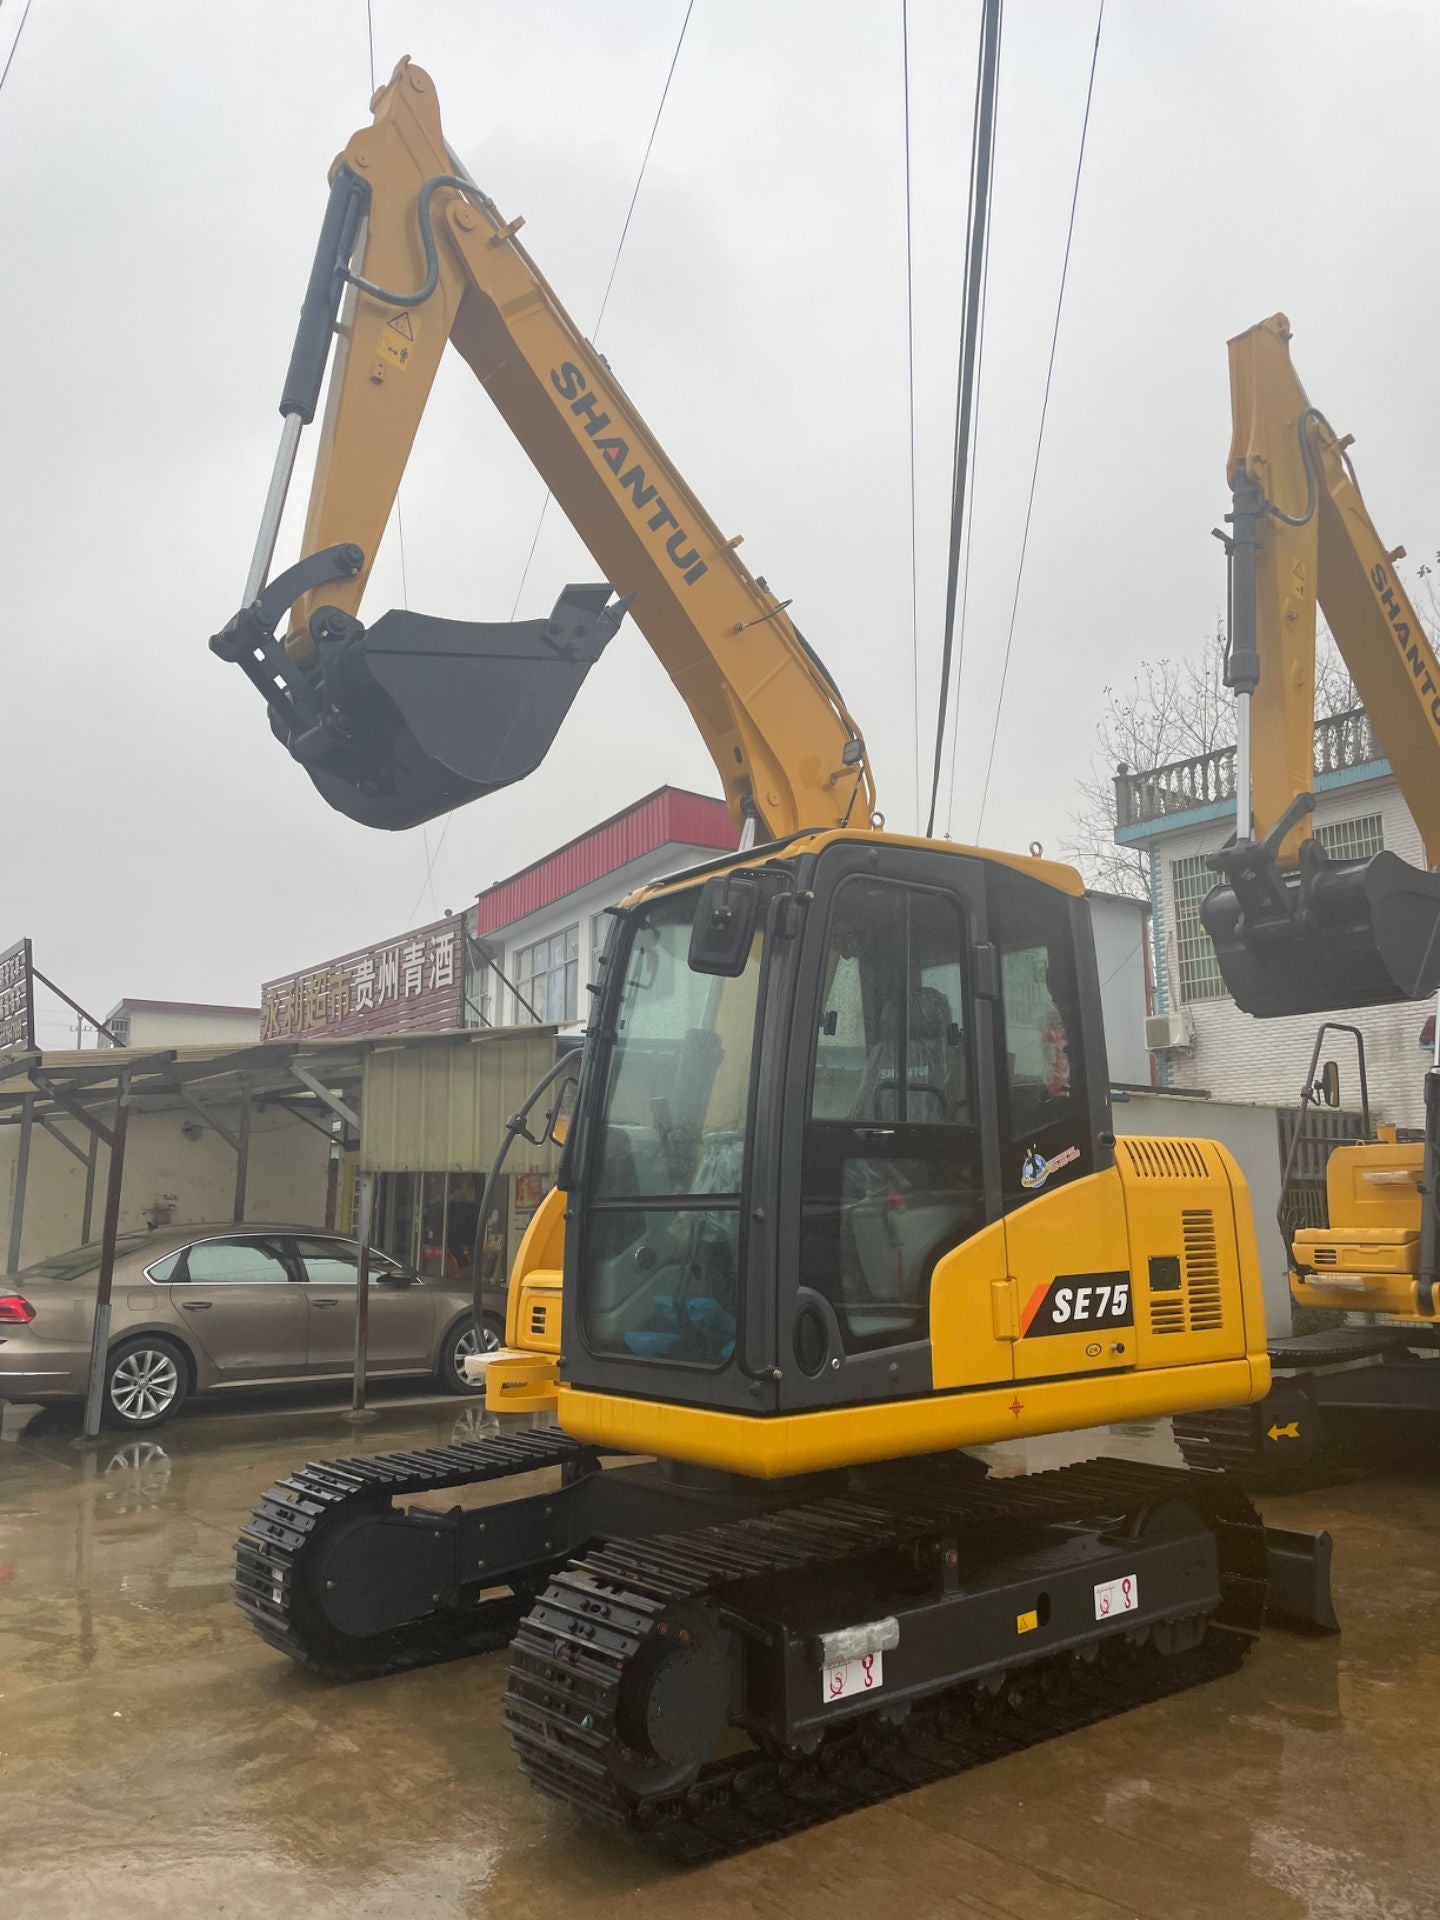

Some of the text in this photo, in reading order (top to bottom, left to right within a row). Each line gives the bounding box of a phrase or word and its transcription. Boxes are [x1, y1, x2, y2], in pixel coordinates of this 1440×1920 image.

[551, 361, 709, 587] SHANTUI
[353, 932, 454, 1012] 贵州青酒
[1052, 1284, 1129, 1324] SE75
